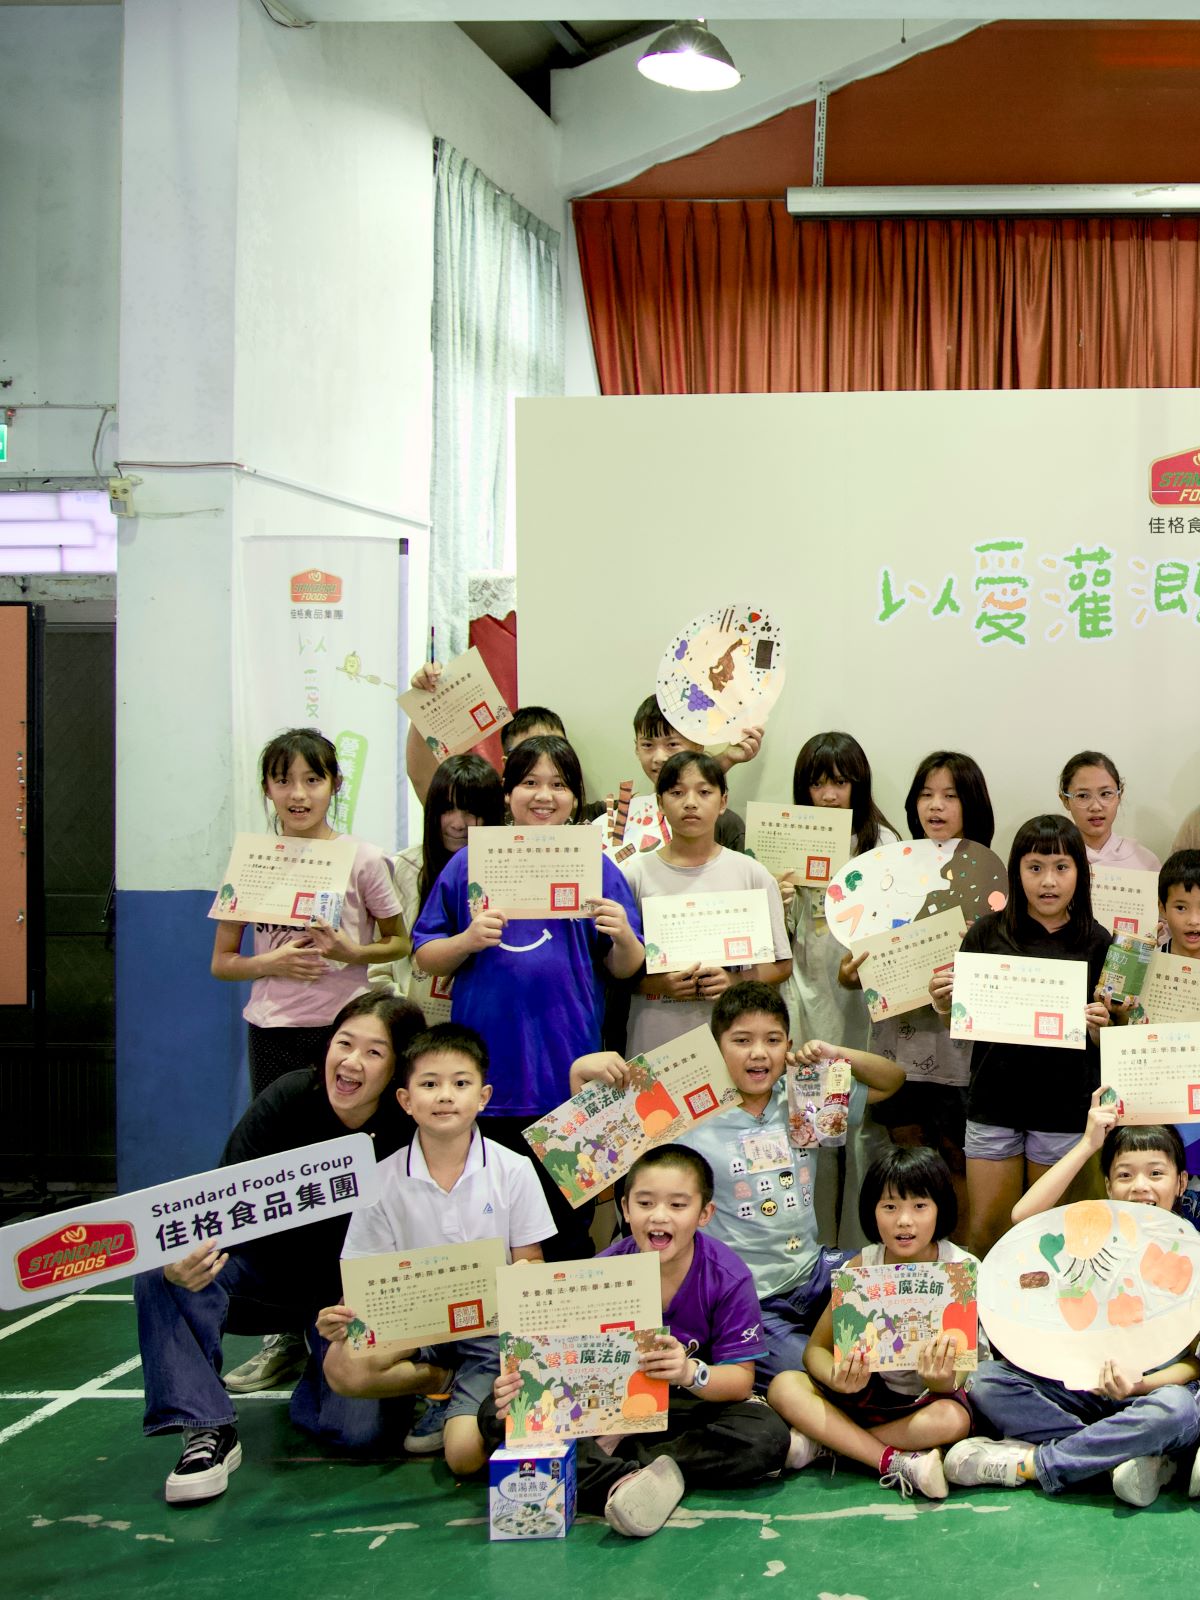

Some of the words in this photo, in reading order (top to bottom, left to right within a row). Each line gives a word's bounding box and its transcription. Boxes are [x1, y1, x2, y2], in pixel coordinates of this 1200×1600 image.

[300, 592, 328, 601] FOODS
[290, 608, 345, 621] 佳格食品集團
[151, 1182, 238, 1218] Standard
[242, 1167, 296, 1191] Foods
[300, 1153, 354, 1177] Group
[155, 1171, 359, 1252] 佳格食品集團
[28, 1233, 126, 1273] STANDARD
[52, 1254, 107, 1281] FOODS
[866, 1278, 945, 1301] 營養魔法師
[545, 1348, 632, 1368] 營養魔法師
